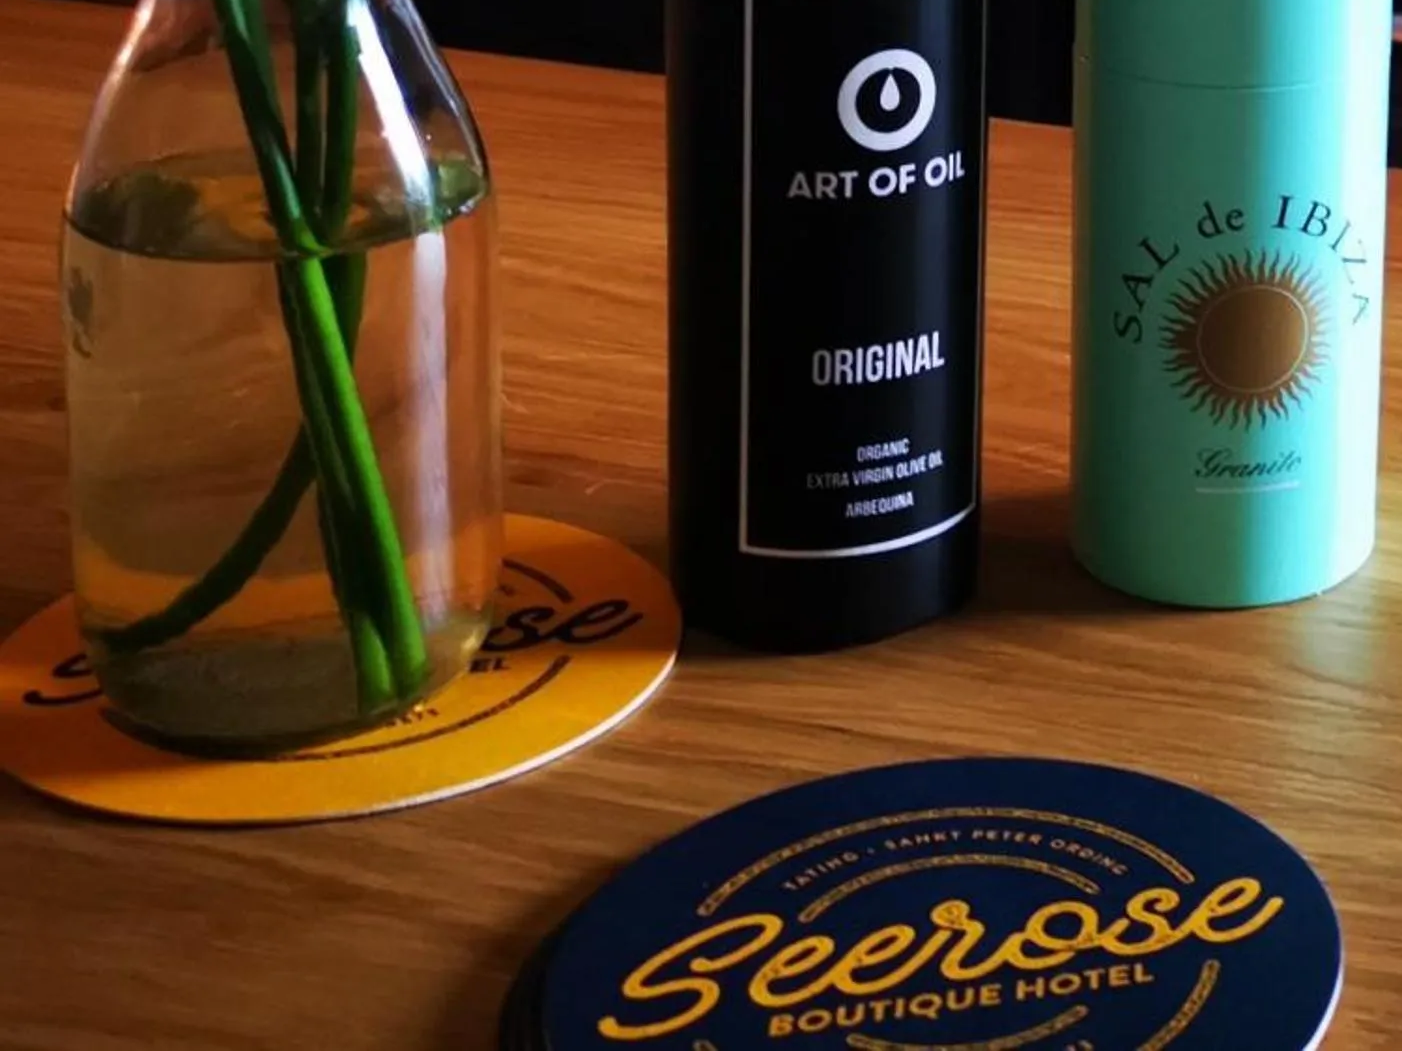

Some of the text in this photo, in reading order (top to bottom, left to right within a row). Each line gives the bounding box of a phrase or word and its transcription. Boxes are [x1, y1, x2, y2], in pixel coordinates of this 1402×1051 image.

[787, 151, 966, 199] ART OF OIL
[1113, 237, 1180, 343] SAL
[1197, 201, 1245, 239] de
[812, 330, 945, 386] ORIGINAL
[806, 450, 944, 489] EXTRA VIRGIN OLIVE OIL
[856, 437, 911, 462] ORGANIC
[845, 491, 915, 518] ARBEQUINA
[783, 850, 860, 891] TATING
[884, 828, 962, 851] SANKT
[971, 828, 1043, 846] PETER
[598, 877, 1285, 1039] Seerose
[767, 962, 1155, 1038] BOUTIQUE HOTEL
